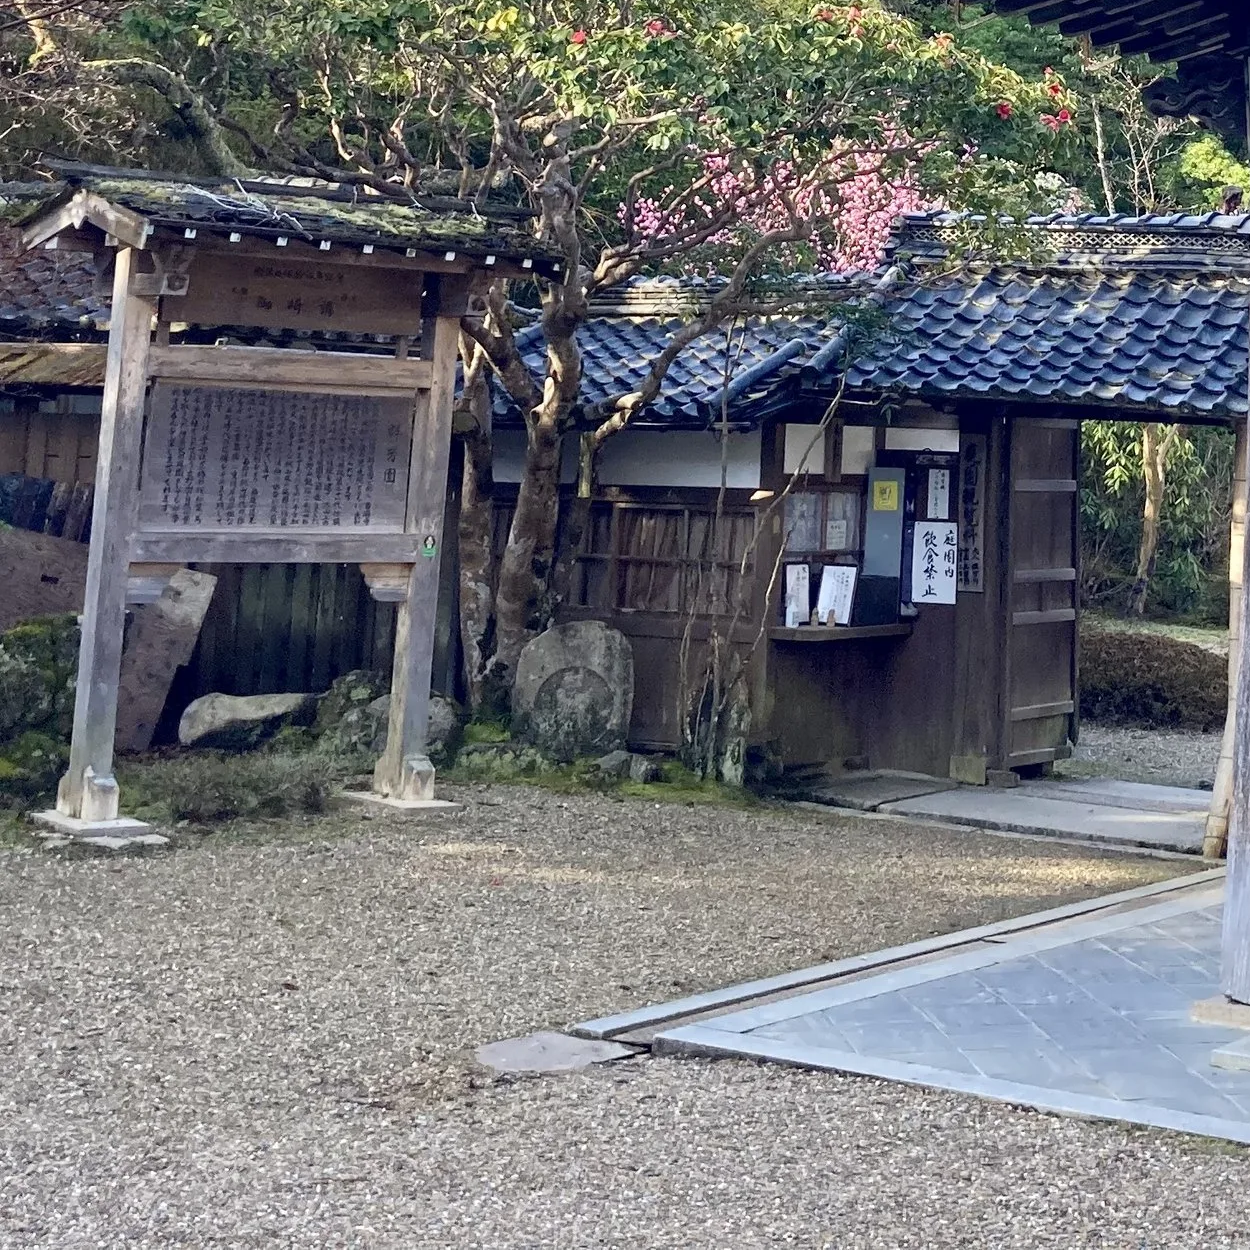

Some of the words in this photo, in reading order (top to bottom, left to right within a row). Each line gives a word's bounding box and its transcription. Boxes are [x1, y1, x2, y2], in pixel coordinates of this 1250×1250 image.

[921, 530, 940, 598] 飲食禁止
[943, 530, 957, 578] 庭園内
